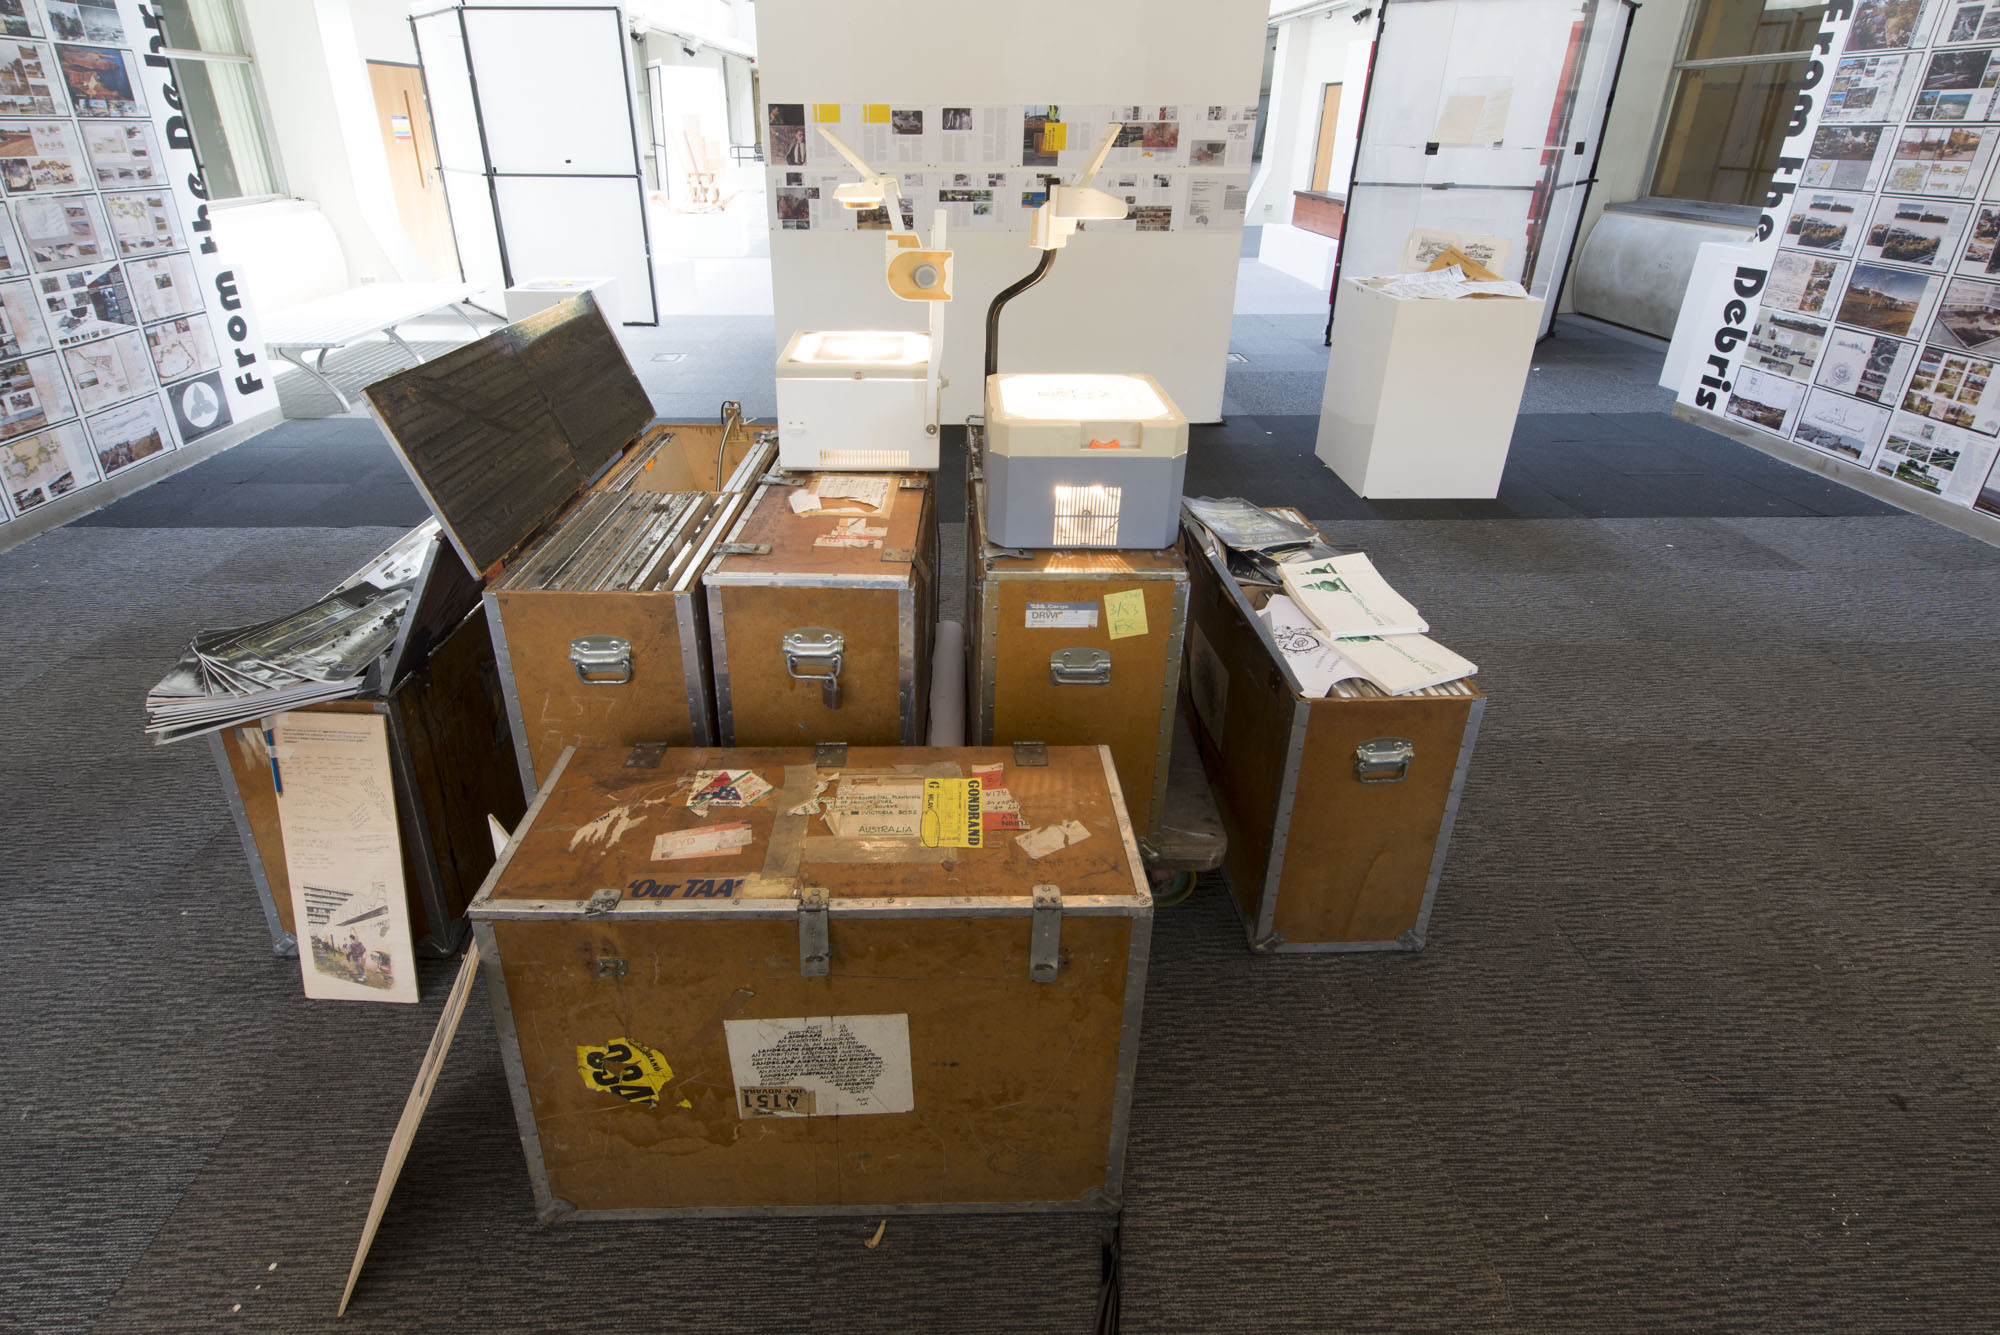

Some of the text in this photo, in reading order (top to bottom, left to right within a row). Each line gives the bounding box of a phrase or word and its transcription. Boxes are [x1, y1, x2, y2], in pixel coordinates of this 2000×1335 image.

[188, 172, 218, 255] the
[1755, 157, 1805, 242] the
[215, 270, 264, 396] From
[1695, 266, 1769, 411] Debris
[859, 825, 912, 833] AUSTRALIA
[968, 779, 981, 846] GONDRAND
[744, 1094, 798, 1109] 4151
